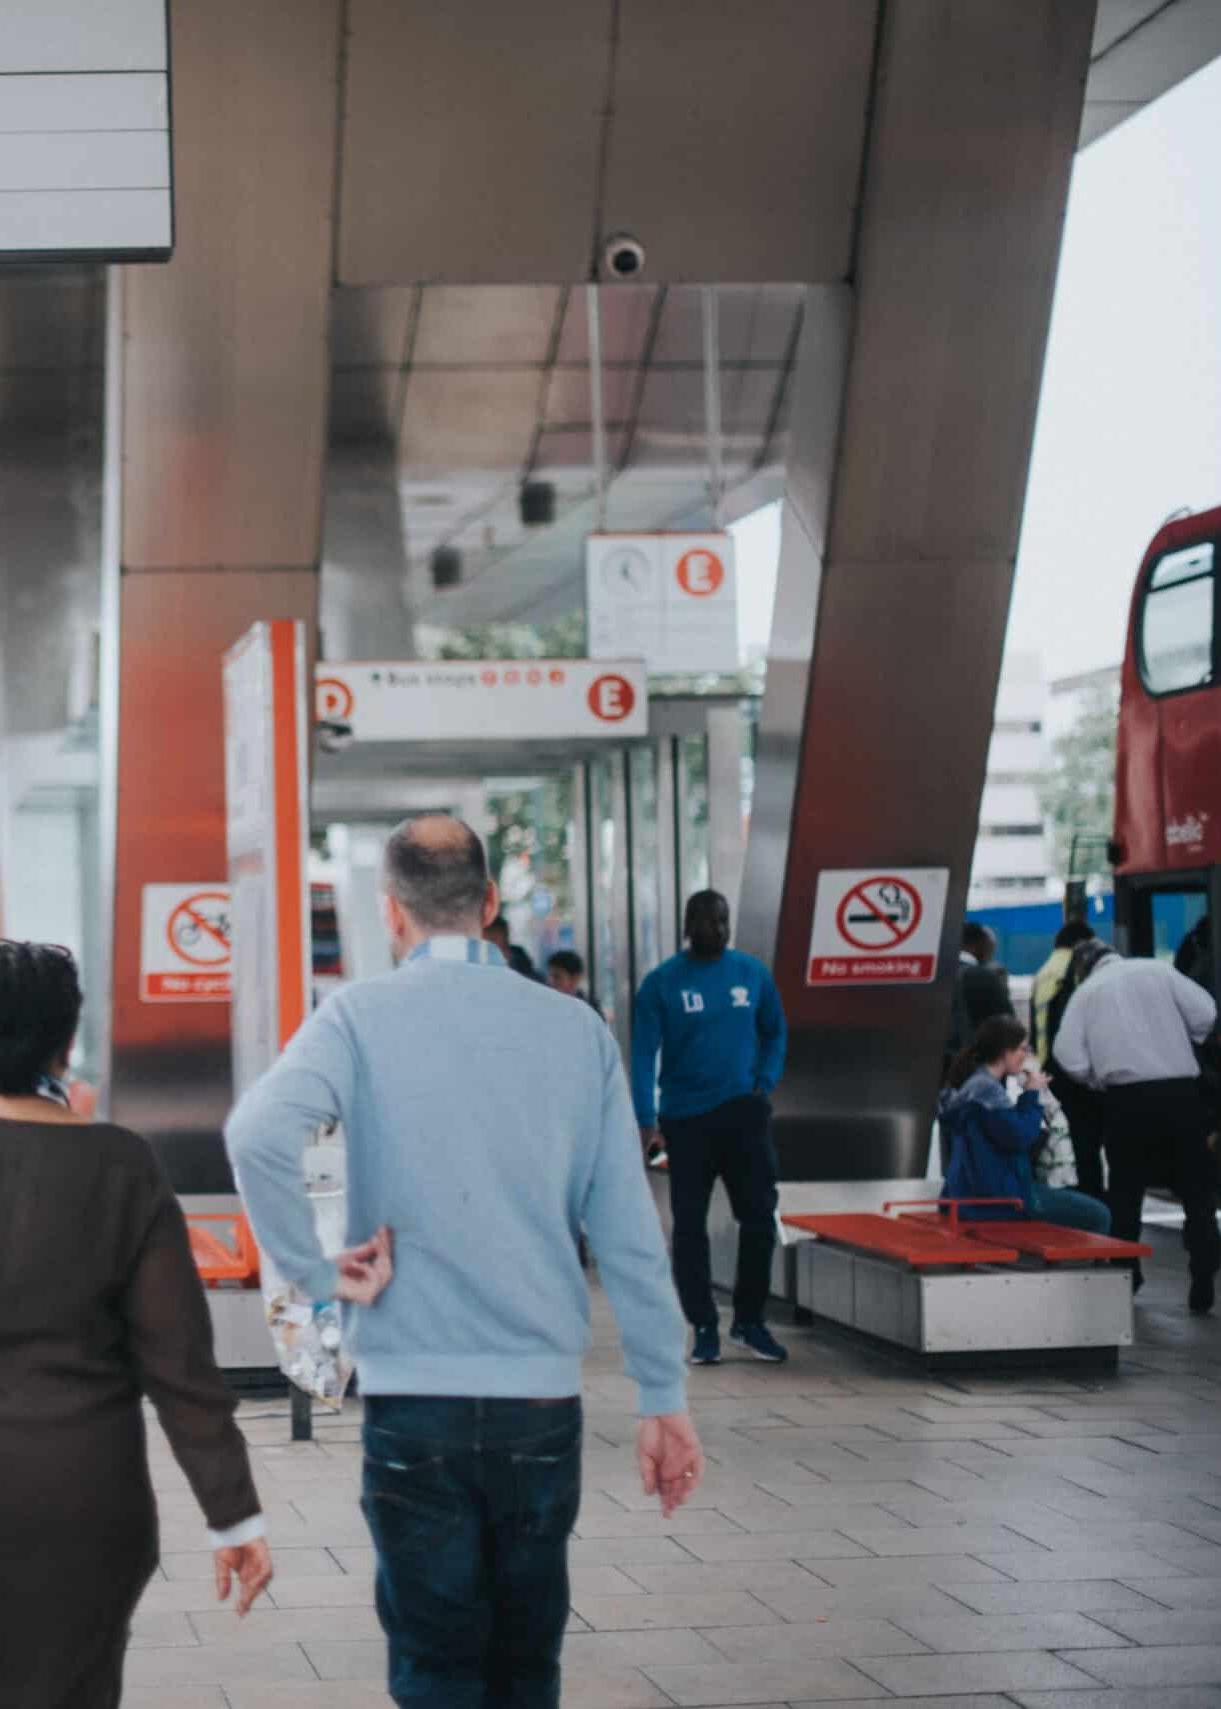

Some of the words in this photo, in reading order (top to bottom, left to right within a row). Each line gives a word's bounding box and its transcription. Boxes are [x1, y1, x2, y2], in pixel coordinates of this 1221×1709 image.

[688, 555, 711, 592] E
[599, 680, 623, 717] E
[821, 960, 847, 976] No
[852, 957, 921, 977] smoking
